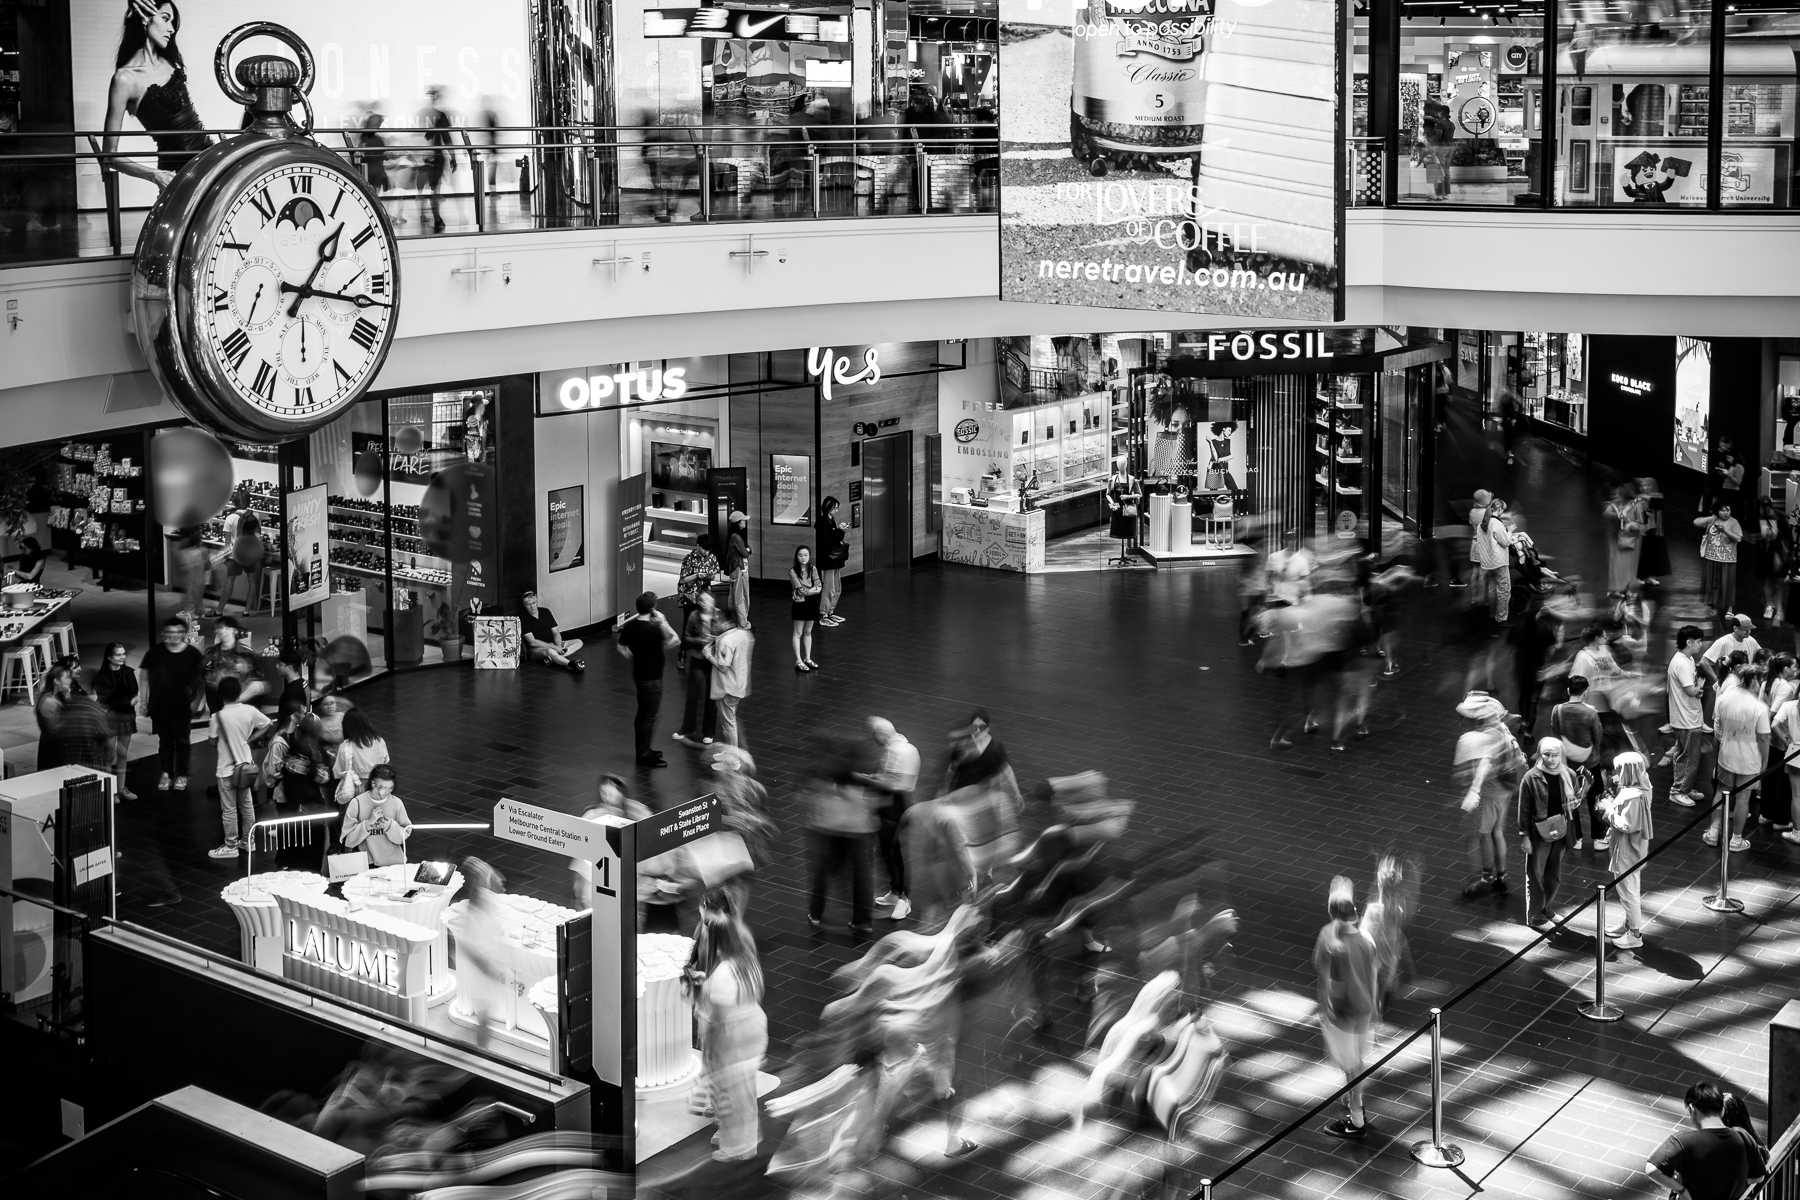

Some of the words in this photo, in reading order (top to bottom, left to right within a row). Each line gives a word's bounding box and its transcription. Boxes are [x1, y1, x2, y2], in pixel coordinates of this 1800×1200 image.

[1075, 23, 1119, 41] open
[1125, 20, 1141, 36] to
[1146, 17, 1238, 40] possibility
[1136, 39, 1160, 51] ANNO
[1163, 46, 1182, 56] 1753
[277, 41, 522, 100] ONESS
[1121, 63, 1196, 85] Classic
[1154, 93, 1165, 109] 5
[1135, 114, 1162, 122] MEDIUM
[1164, 114, 1185, 122] ROAST
[248, 185, 277, 230] XI
[328, 187, 346, 219] I
[1056, 182, 1092, 201] FOR
[1097, 182, 1231, 225] LOVERS
[221, 227, 252, 260] X
[280, 234, 322, 246] SEIKO
[350, 223, 376, 252] II
[1126, 221, 1151, 241] OF
[1155, 219, 1268, 254] COFFEE
[372, 274, 384, 294] III
[1039, 258, 1305, 292] neretravel.com.au
[213, 283, 229, 314] IX
[279, 323, 290, 340] SAT
[316, 320, 326, 337] MON
[349, 317, 379, 353] IIII
[221, 328, 253, 374] VIII
[1208, 332, 1334, 361] FOSSIL
[249, 359, 278, 402] VII
[332, 358, 353, 390] V
[807, 347, 881, 400] yes
[559, 367, 688, 410] OPTUS
[1630, 378, 1652, 392] BLACK
[293, 387, 316, 406] VI
[962, 400, 1004, 412] FREE
[367, 440, 384, 452] FRES
[958, 446, 1009, 459] EMBOSSING
[774, 464, 792, 474] Epic
[774, 473, 808, 482] internet
[777, 482, 798, 490] deals
[292, 498, 322, 518] MINTY
[550, 500, 566, 512] Epic
[550, 508, 580, 520] internet
[292, 512, 321, 532] FRESH
[552, 520, 572, 531] deals
[508, 805, 517, 815] Via
[518, 808, 544, 822] Escalator
[678, 804, 701, 819] Swanston
[702, 802, 708, 811] St
[509, 815, 538, 831] Melbourne
[539, 823, 560, 837] Central
[560, 828, 582, 842] Station
[660, 824, 673, 837] RMIT
[679, 818, 691, 831] State
[692, 812, 710, 828] Library
[683, 827, 694, 839] Knox
[695, 822, 710, 836] Place
[508, 826, 526, 838] Lower
[526, 830, 548, 844] Ground
[548, 836, 566, 849] Eatery
[596, 856, 617, 898] 1
[290, 920, 397, 989] LALUME
